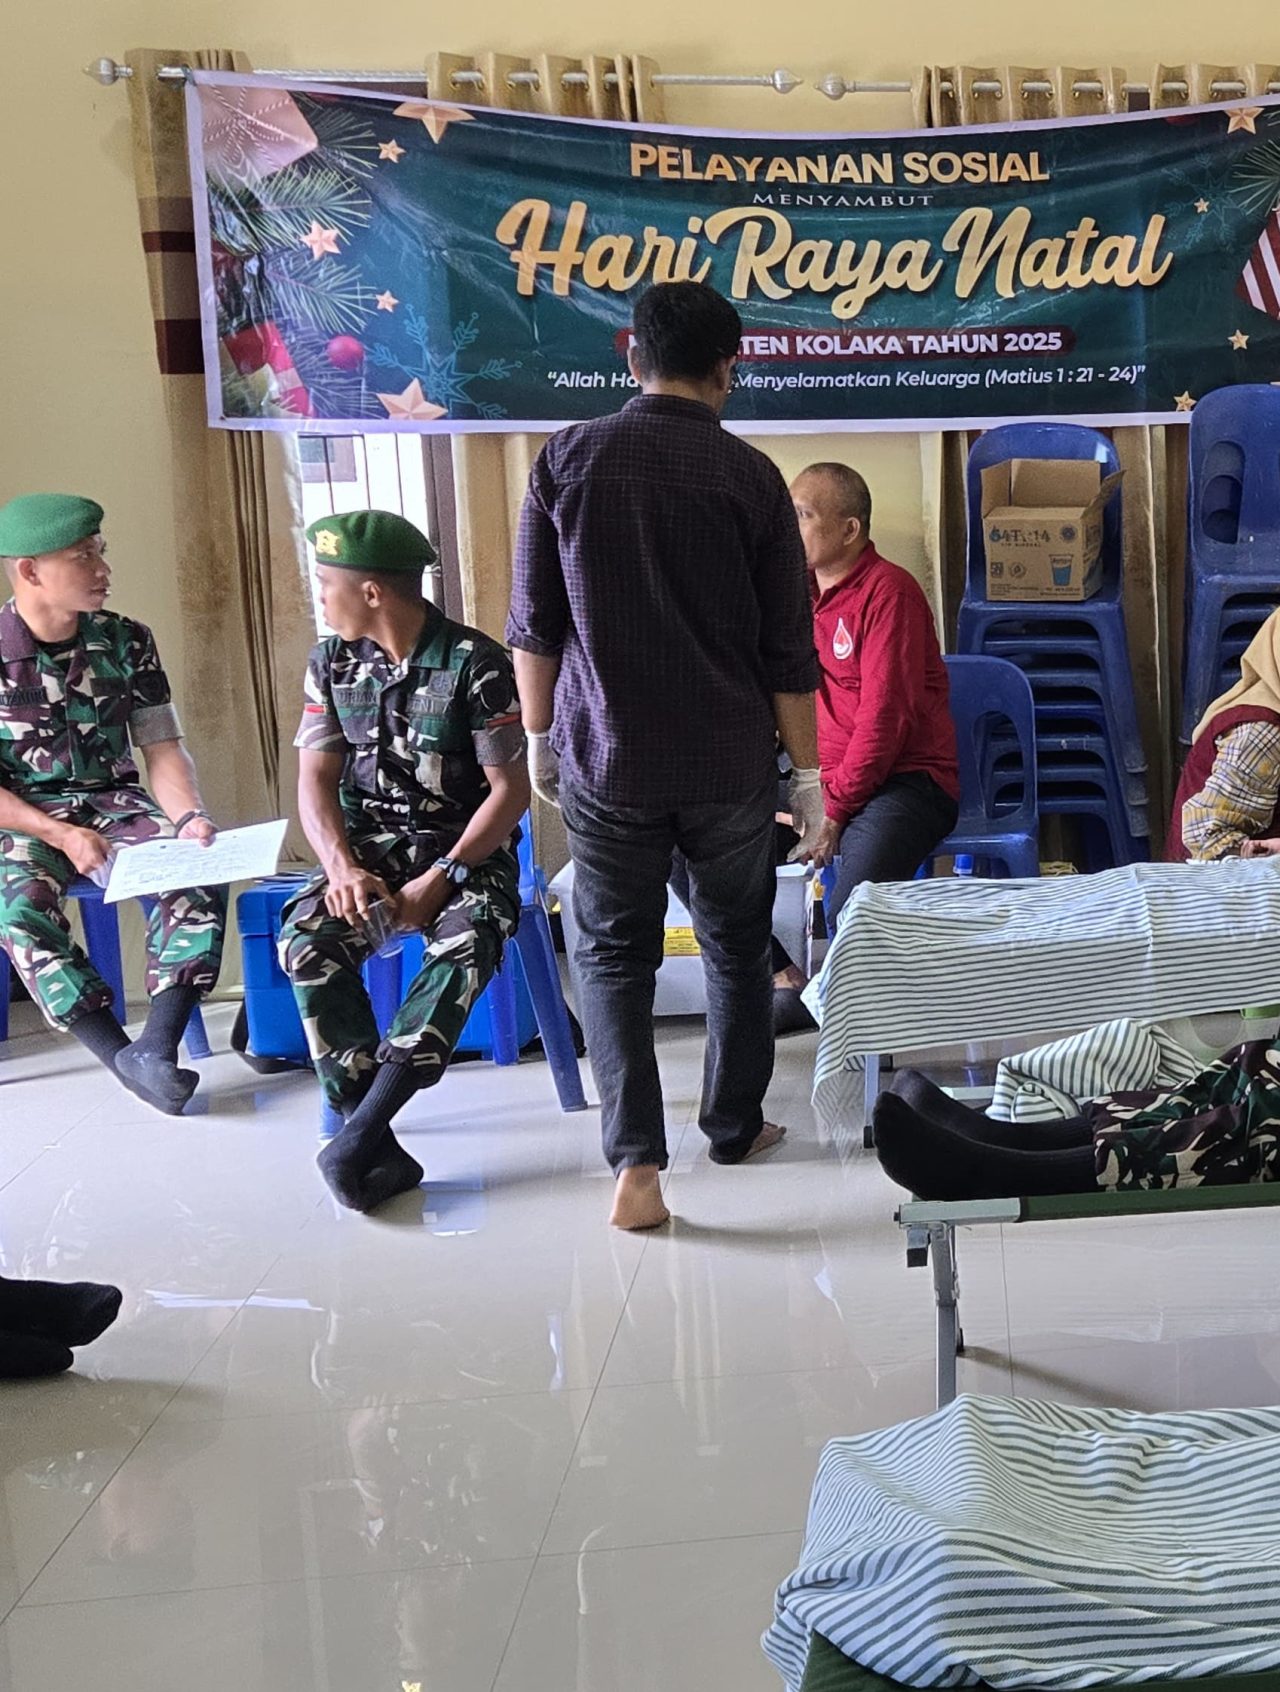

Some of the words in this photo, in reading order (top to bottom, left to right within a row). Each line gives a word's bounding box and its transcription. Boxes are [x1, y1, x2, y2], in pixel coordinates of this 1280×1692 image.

[630, 142, 894, 184] PELAYANAN
[903, 151, 1050, 184] SOSIAL
[753, 193, 934, 207] MENYAMBUT
[495, 199, 712, 297] Hari
[704, 206, 944, 320] Raya
[941, 206, 1174, 298] Natal
[796, 334, 903, 356] KOLAKA
[907, 333, 999, 354] TAHUN
[1004, 332, 1062, 351] 2025
[547, 371, 606, 388] “Allah
[737, 370, 891, 392] Menyelamatkan
[896, 370, 980, 388] Keluarga
[985, 368, 1053, 388] (Matius
